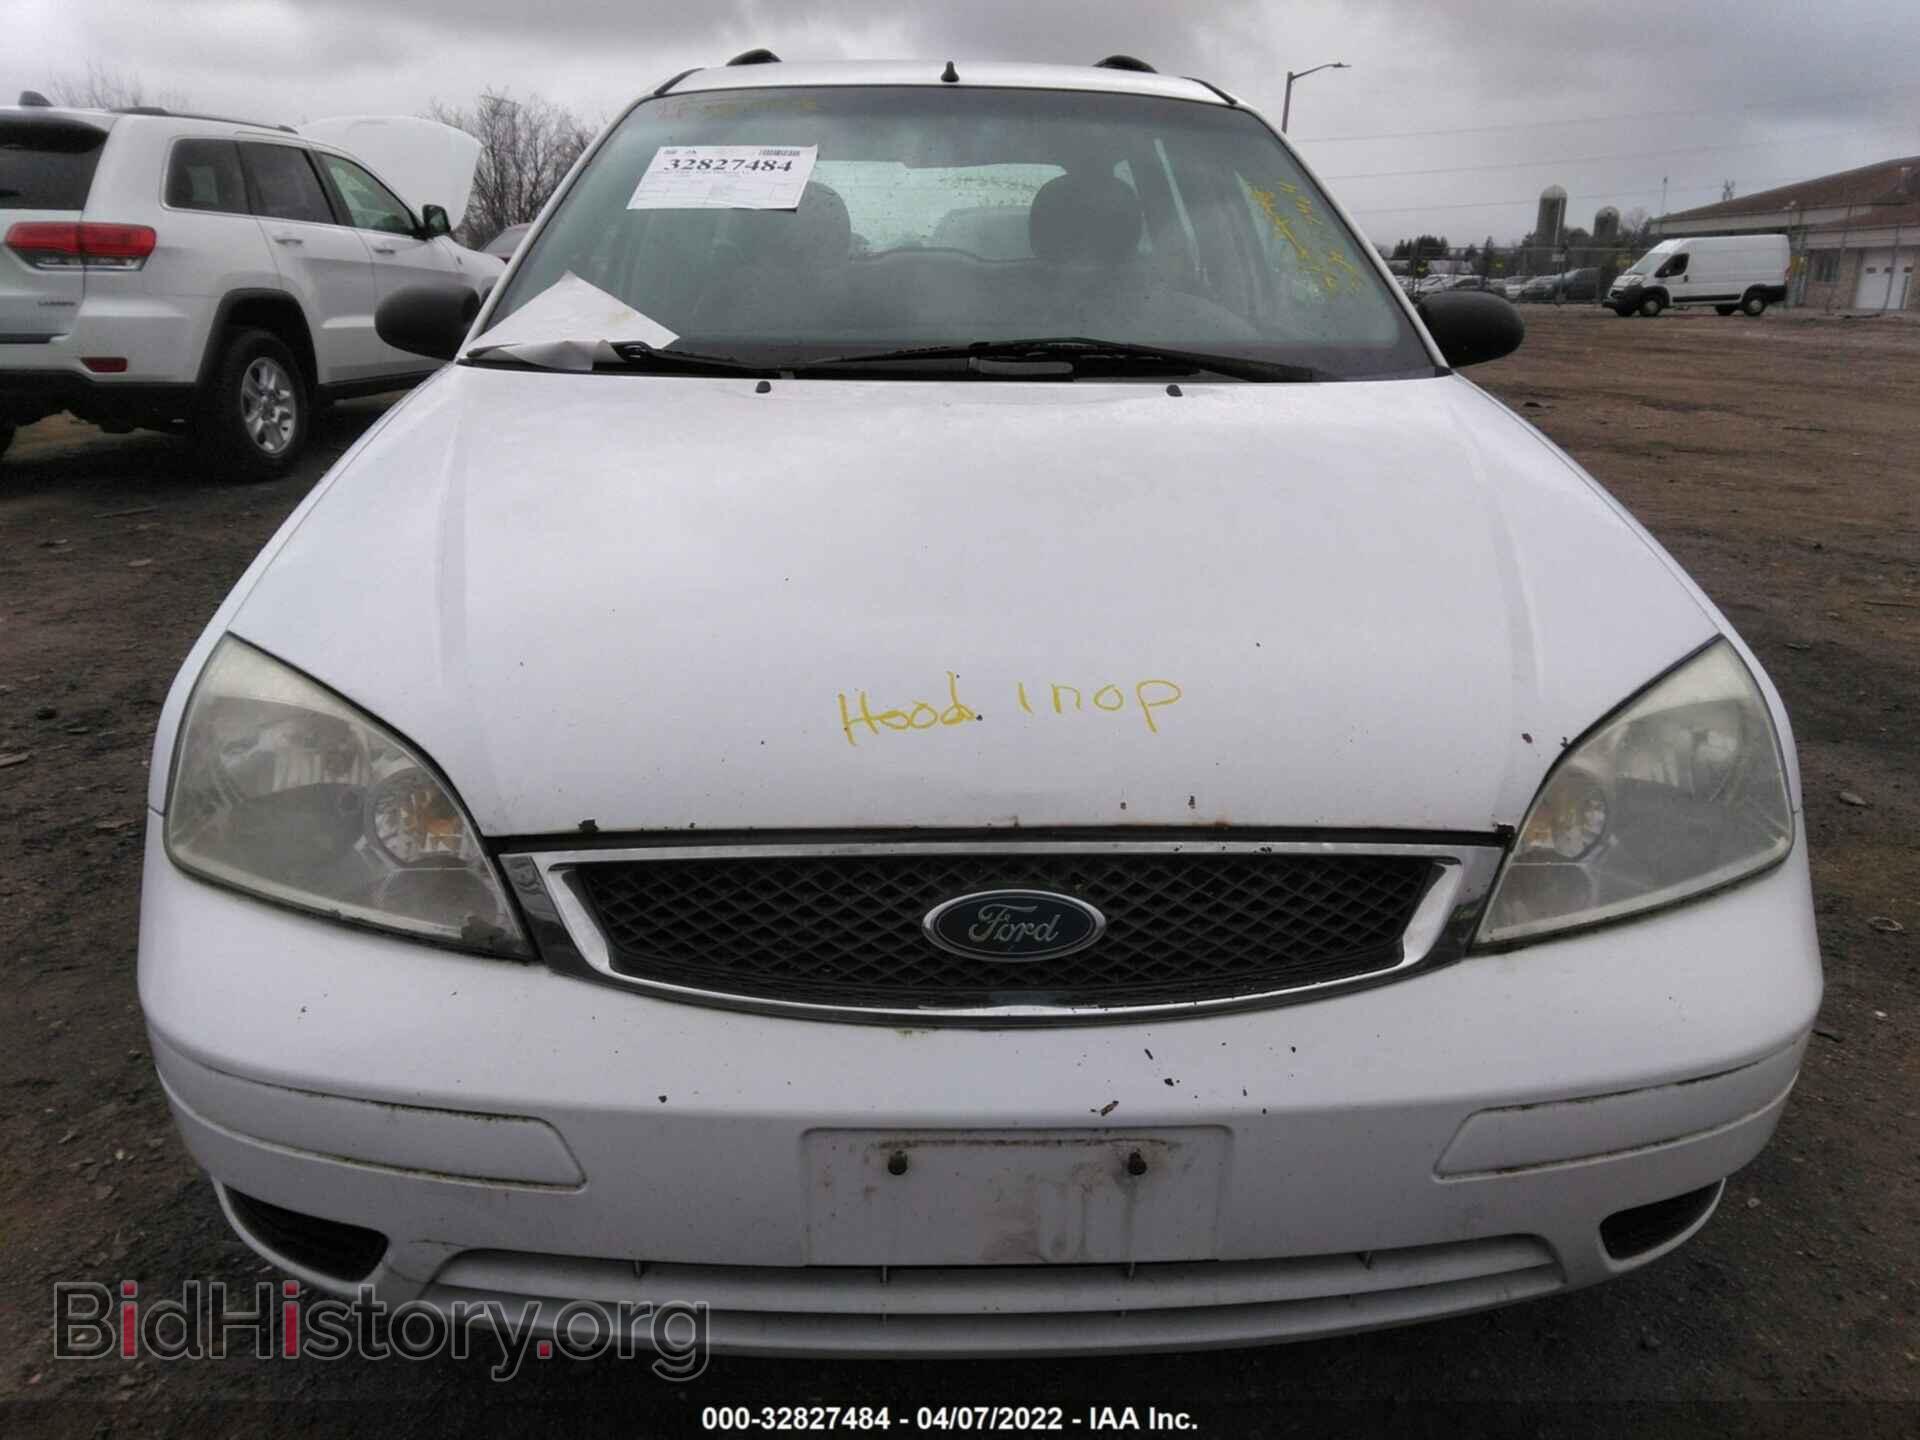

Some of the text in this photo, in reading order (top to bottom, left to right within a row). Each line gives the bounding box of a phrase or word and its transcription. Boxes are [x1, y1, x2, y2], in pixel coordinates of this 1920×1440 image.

[664, 158, 793, 172] 32827484
[839, 671, 976, 746] Hood
[968, 903, 1061, 942] Ford
